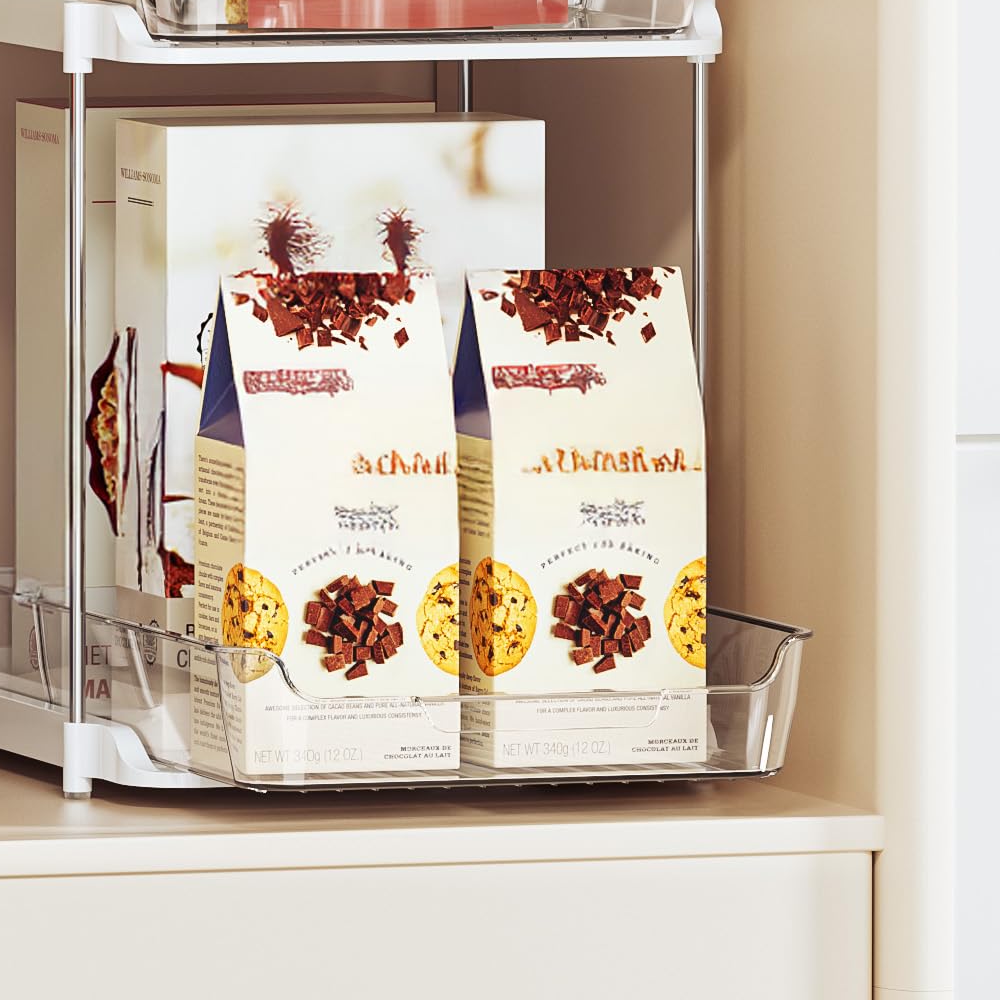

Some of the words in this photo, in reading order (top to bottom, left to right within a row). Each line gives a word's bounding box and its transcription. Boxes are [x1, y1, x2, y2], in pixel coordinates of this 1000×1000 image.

[254, 750, 273, 764] NET
[503, 743, 521, 758] NET
[524, 742, 541, 757] WT
[543, 741, 569, 759] 340g
